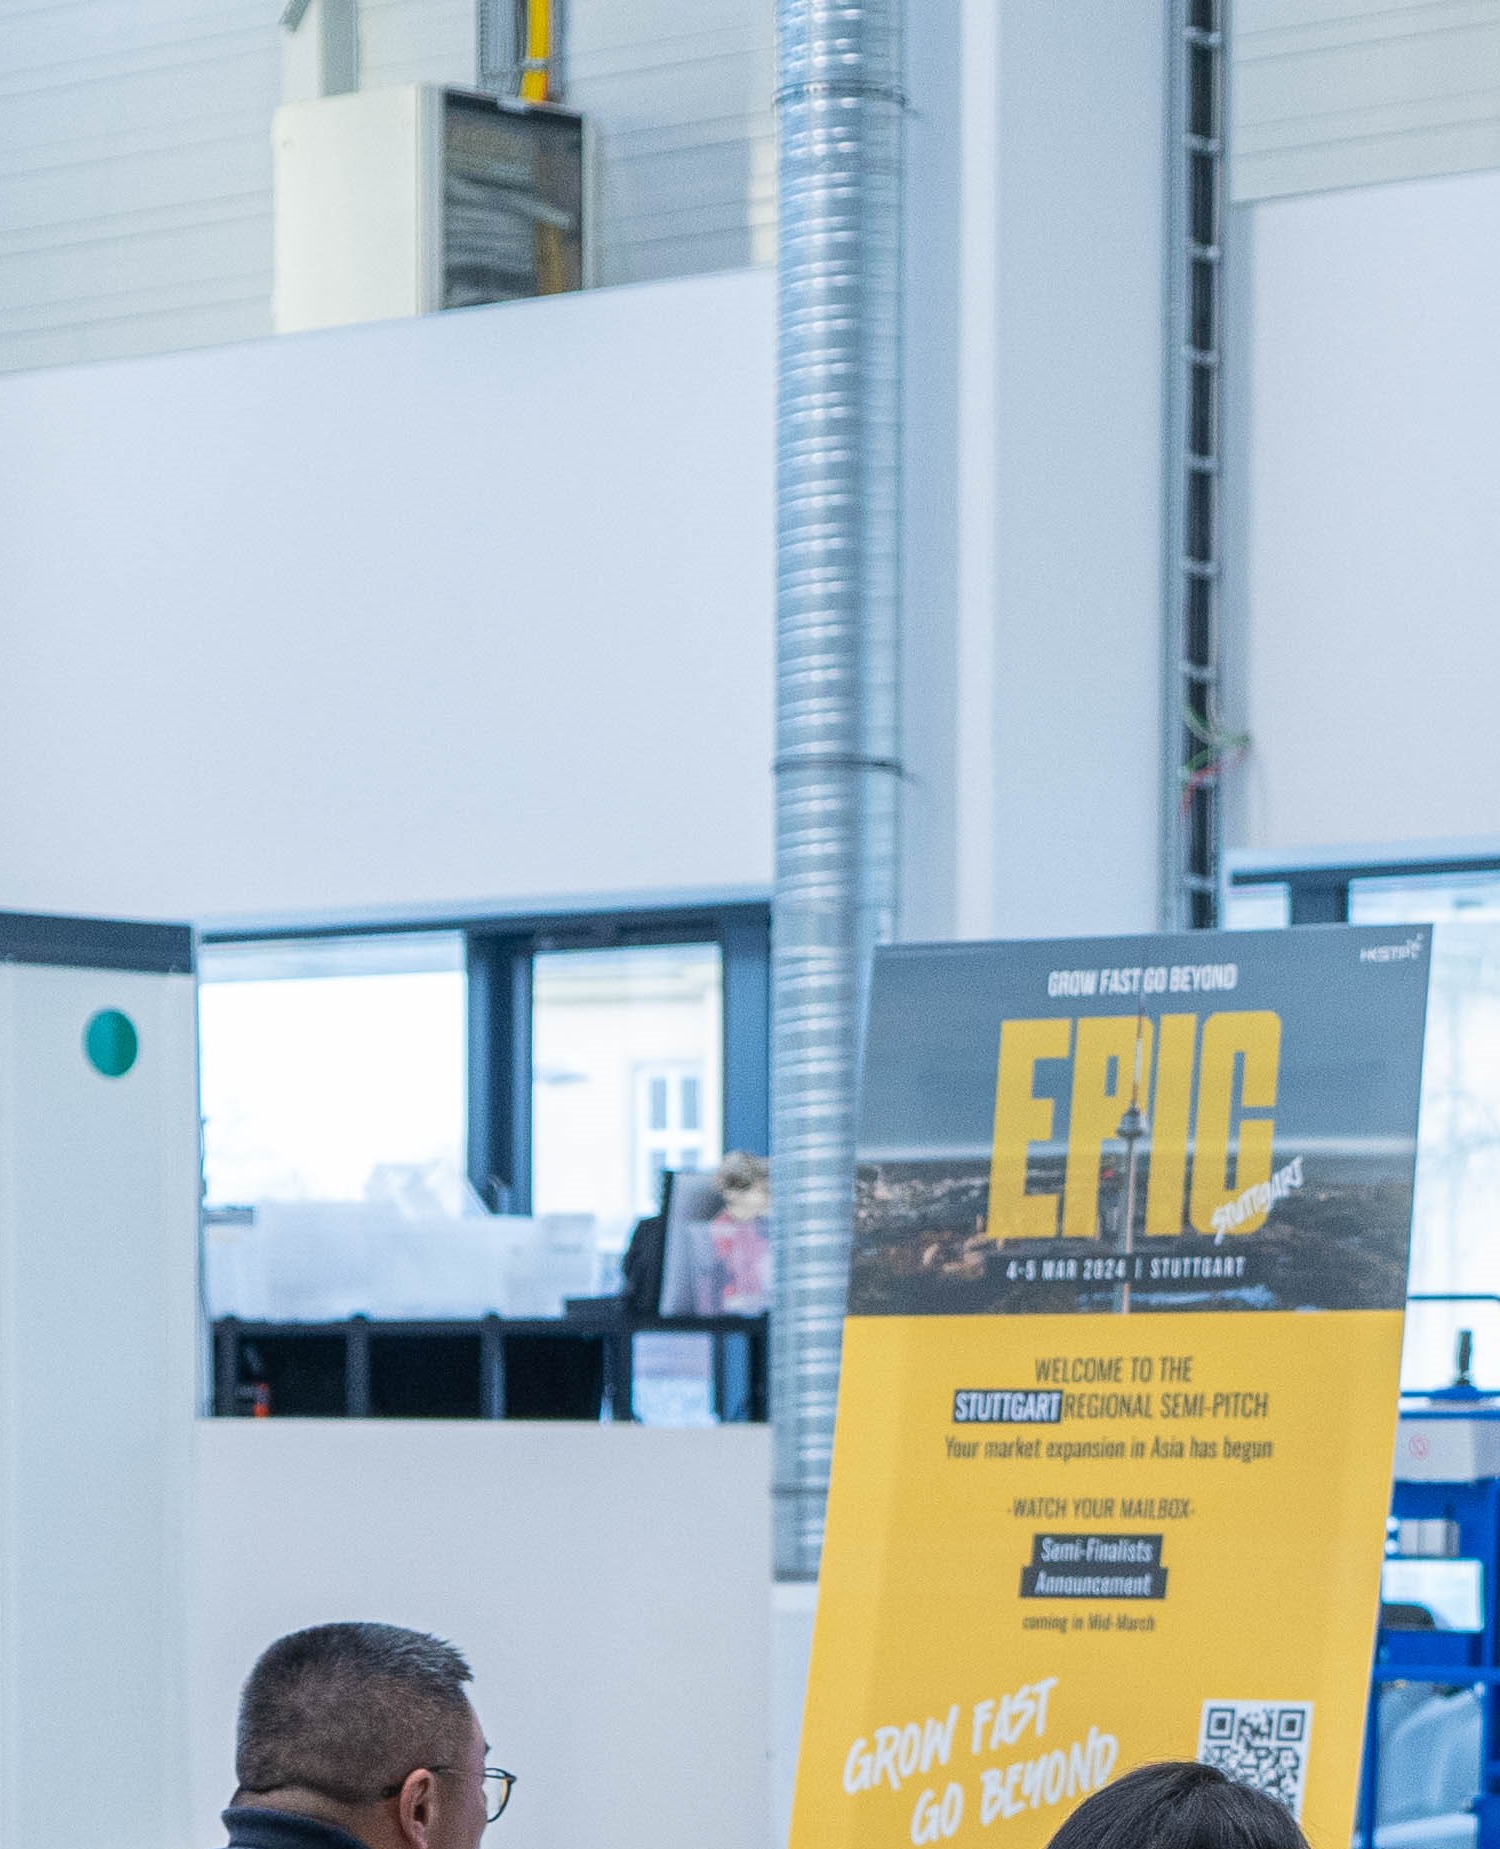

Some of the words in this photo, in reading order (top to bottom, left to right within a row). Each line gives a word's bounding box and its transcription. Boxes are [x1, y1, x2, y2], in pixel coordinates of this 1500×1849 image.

[1048, 969, 1097, 997] GROW
[1100, 967, 1141, 995] FAST
[1143, 966, 1168, 993] GO
[1169, 963, 1238, 992] BEYOND
[987, 1010, 1282, 1239] EPIC
[1006, 1260, 1037, 1281] 4-5
[1041, 1259, 1078, 1281] MAR
[1083, 1258, 1127, 1280] 2024
[1150, 1256, 1247, 1280] STUTTGART
[1035, 1356, 1124, 1384] WELCOME
[1130, 1356, 1153, 1383] TO
[1159, 1355, 1192, 1383] THE
[955, 1391, 1063, 1422] STUTTGART
[1063, 1392, 1153, 1419] REGIONAL
[1160, 1392, 1269, 1419] SEMI-PITCH
[945, 1435, 980, 1459] Your
[984, 1436, 1042, 1459] market
[1046, 1436, 1126, 1462] expansion
[1130, 1435, 1145, 1459] in
[1150, 1435, 1183, 1459] Asia
[1190, 1435, 1217, 1459] has
[1223, 1435, 1273, 1464] begun
[1073, 1496, 1115, 1519] YOUR
[1040, 1537, 1153, 1562] Semi-Finalists
[1034, 1570, 1152, 1597] Announcement
[1022, 1615, 1068, 1635] coming
[1072, 1615, 1084, 1631] in
[1087, 1613, 1156, 1632] Mid-March
[843, 1703, 960, 1795] GROW
[971, 1677, 1058, 1755] FAST
[911, 1783, 962, 1846] GO
[980, 1725, 1120, 1825] BEYOND
